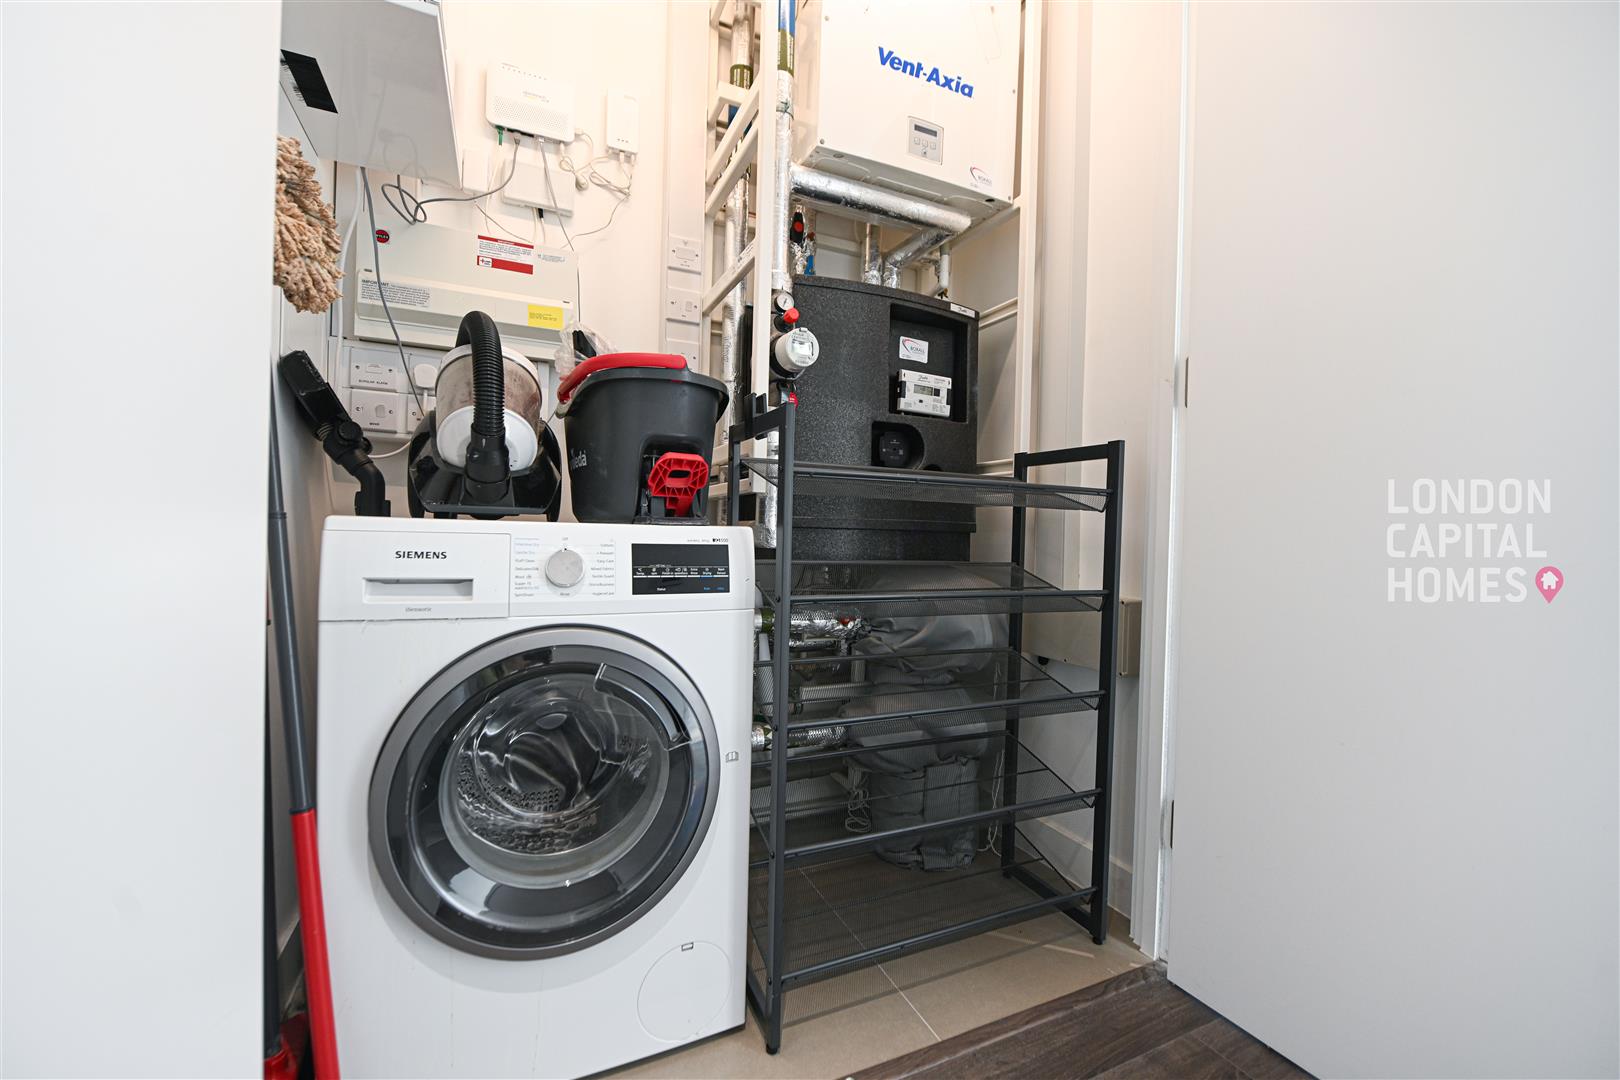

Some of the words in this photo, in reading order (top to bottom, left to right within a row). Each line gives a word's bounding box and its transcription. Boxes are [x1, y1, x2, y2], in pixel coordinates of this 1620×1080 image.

[878, 46, 974, 98] Vent-Axia
[361, 279, 390, 287] IMPORANT
[395, 550, 447, 560] SIEMENS
